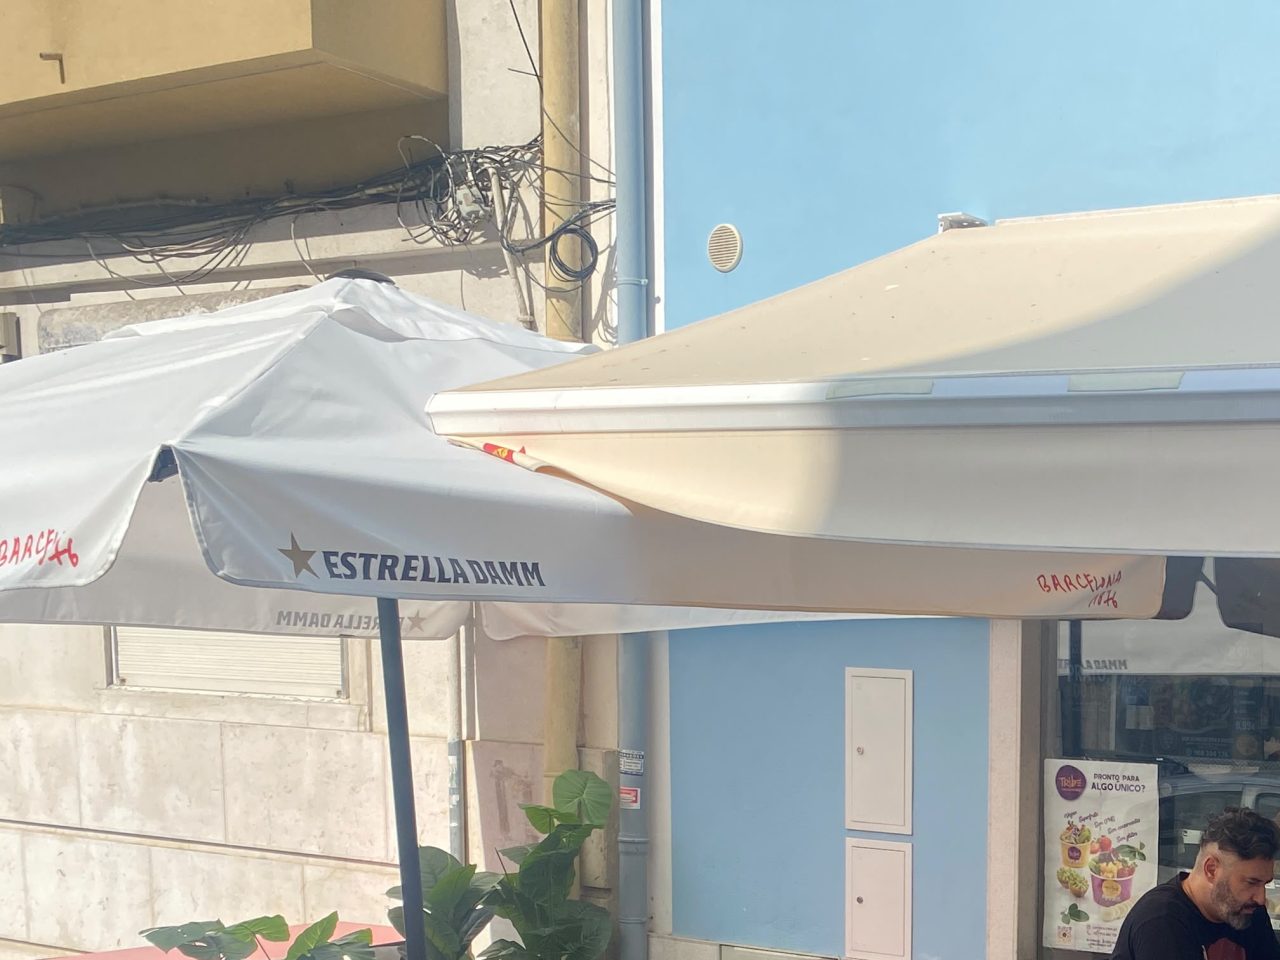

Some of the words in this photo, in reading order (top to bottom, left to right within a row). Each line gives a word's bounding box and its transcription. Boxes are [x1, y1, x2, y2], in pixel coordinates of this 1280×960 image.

[322, 551, 470, 584] ESTRELLA
[466, 559, 546, 587] DAMM
[1091, 782, 1113, 791] ALGO
